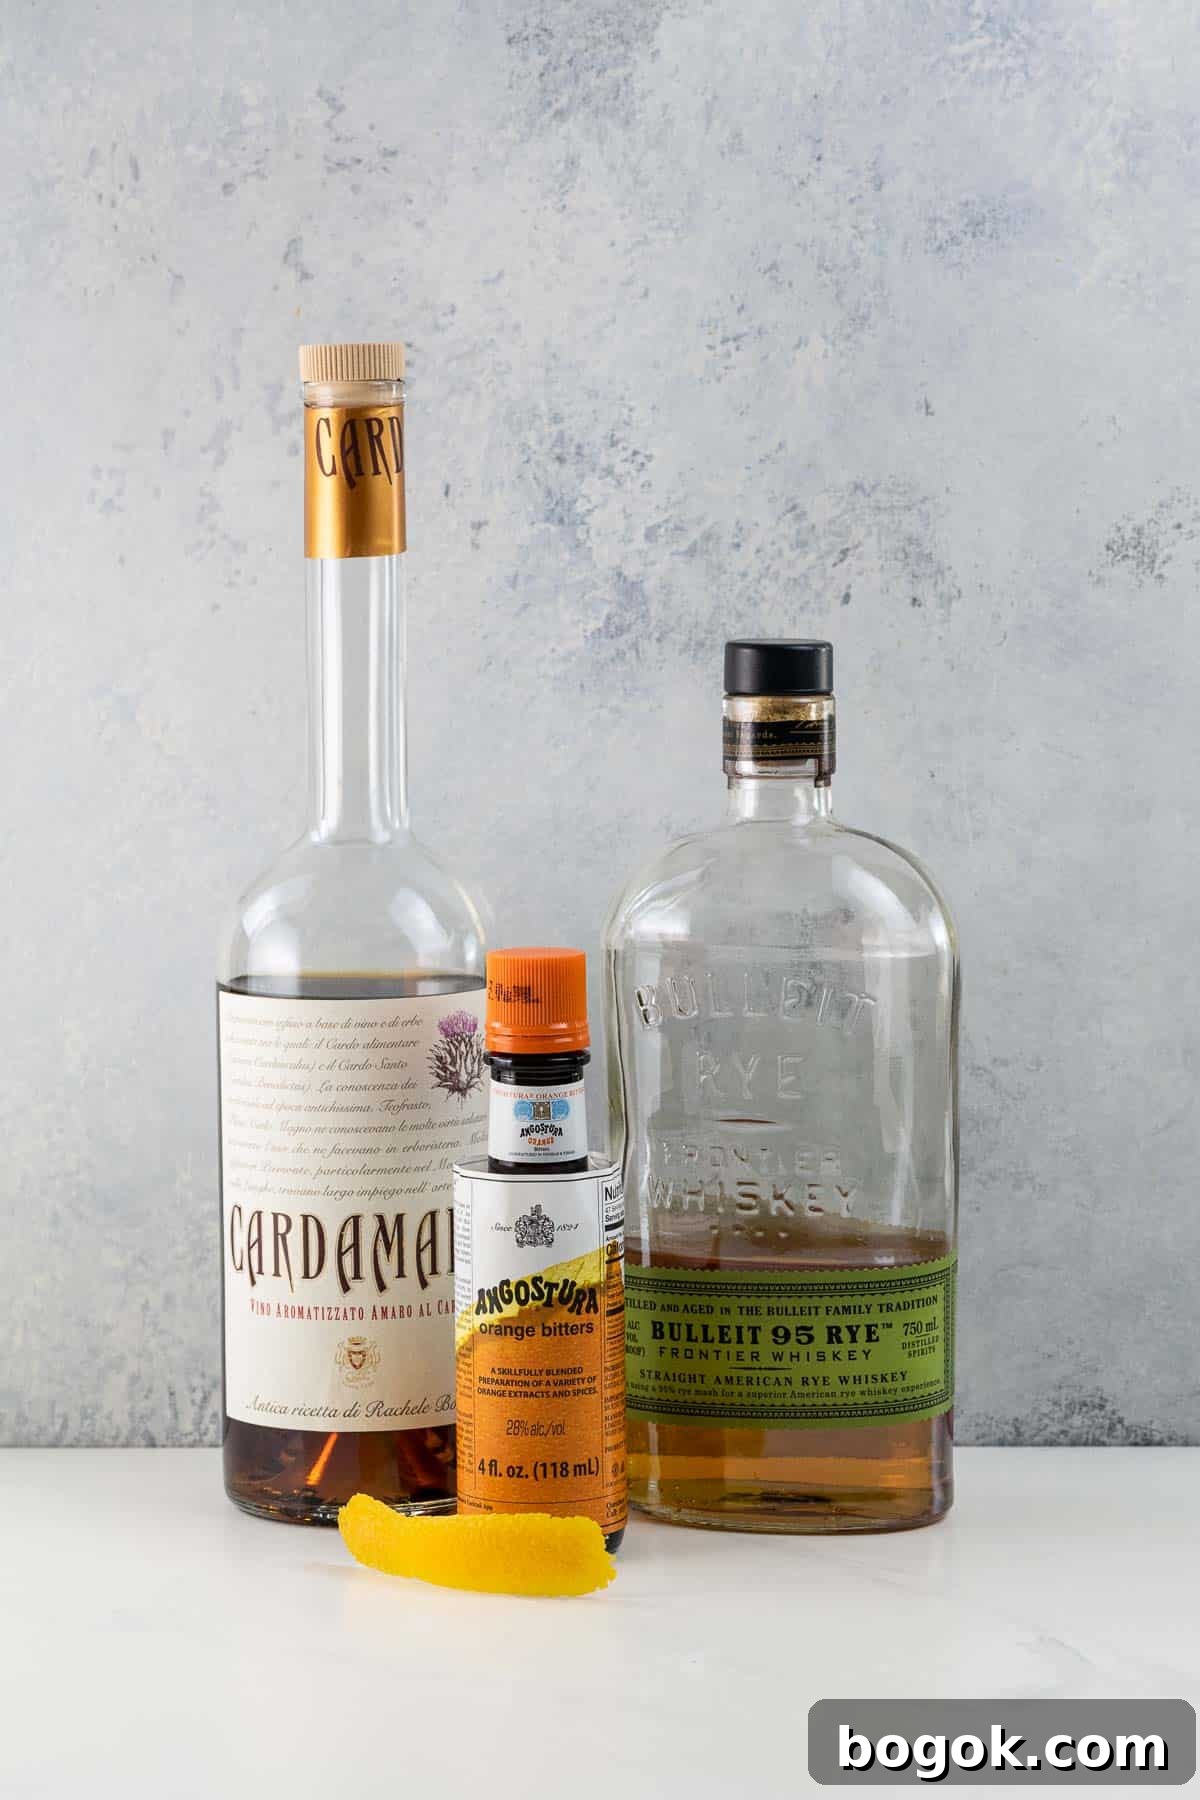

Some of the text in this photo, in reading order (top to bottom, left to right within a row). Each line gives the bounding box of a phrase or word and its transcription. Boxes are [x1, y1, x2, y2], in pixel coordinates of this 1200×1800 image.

[315, 417, 403, 490] CARD
[635, 973, 876, 1036] BULLEIT
[326, 1036, 360, 1050] Cardo
[362, 1037, 418, 1050] alimentare
[338, 1057, 373, 1072] Cardo
[374, 1056, 408, 1071] Santo
[696, 1052, 807, 1100] RYE
[335, 1081, 400, 1093] conoscenza
[377, 1098, 432, 1116] Teofrasto,
[520, 1123, 563, 1138] ANGOSTURA
[528, 1137, 555, 1146] ORANGE
[663, 1145, 841, 1175] FRONTIER
[312, 1162, 413, 1181] particolarmente
[321, 1184, 355, 1201] largo
[356, 1185, 404, 1201] impiego
[649, 1176, 857, 1219] WHISKEY
[491, 1223, 512, 1233] Since
[475, 1276, 599, 1316] ANGOSTURA
[275, 1303, 364, 1321] AROMATIZZATO
[371, 1304, 413, 1320] AMARO
[418, 1304, 432, 1317] AL
[660, 1303, 679, 1312] AND
[682, 1304, 714, 1315] AGED
[720, 1307, 730, 1315] IN
[737, 1306, 762, 1316] THE
[767, 1305, 820, 1317] BULLEIT
[825, 1304, 872, 1316] FAMILY
[877, 1294, 938, 1314] TRADITION
[479, 1322, 594, 1341] orange bitters
[651, 1320, 761, 1345] BULLEIT
[771, 1323, 815, 1346] 95
[903, 1321, 922, 1337] 750
[902, 1336, 939, 1350] DISTILLED
[659, 1346, 872, 1363] FRONTIER WHISKEY
[908, 1347, 936, 1359] SPIRITS
[497, 1367, 543, 1376] SKILLFULLY
[545, 1366, 583, 1375] BLENDED
[640, 1368, 706, 1385] STRAIGHT
[713, 1375, 793, 1387] AMERICAN
[801, 1376, 830, 1387] RYE
[838, 1370, 907, 1386] WHISKEY
[478, 1376, 530, 1387] PREPARATION
[532, 1379, 544, 1387] OF
[553, 1377, 586, 1387] VARIETY
[587, 1376, 597, 1384] OF
[477, 1388, 507, 1397] ORANGE
[508, 1390, 549, 1399] EXTRACTS
[552, 1389, 571, 1398] AND
[721, 1388, 734, 1398] for
[746, 1389, 787, 1401] superior
[789, 1389, 836, 1400] American
[839, 1389, 856, 1400] rye
[859, 1385, 897, 1398] whiskey
[246, 1394, 287, 1415] Antica
[290, 1401, 339, 1418] ricetta
[342, 1401, 360, 1419] di
[364, 1398, 430, 1418] Rachele
[506, 1419, 528, 1437] 28%
[478, 1458, 485, 1475] 4
[488, 1459, 502, 1477] fl.
[506, 1464, 528, 1479] oz.
[534, 1461, 569, 1481] (118
[573, 1457, 600, 1477] mL)
